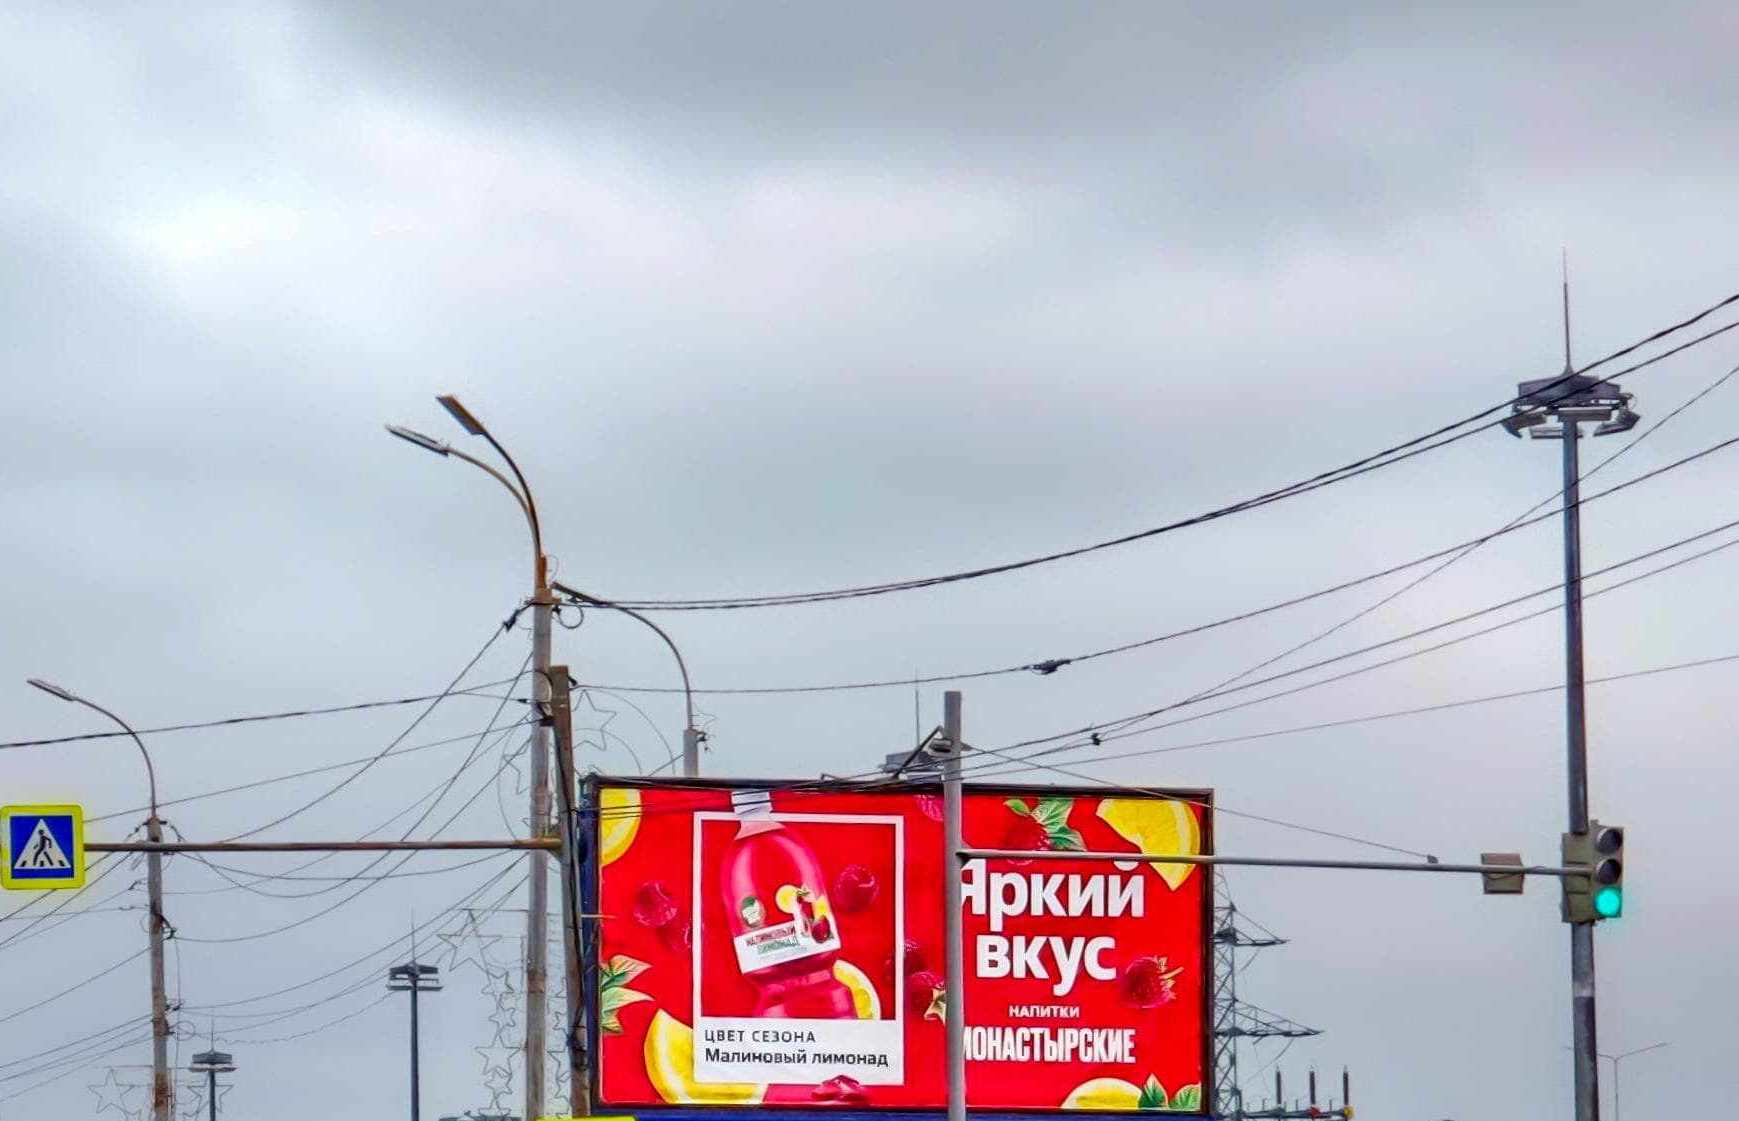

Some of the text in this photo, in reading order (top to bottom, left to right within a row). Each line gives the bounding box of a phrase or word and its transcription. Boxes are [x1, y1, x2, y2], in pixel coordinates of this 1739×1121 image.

[961, 858, 1145, 932] Яркий
[976, 934, 1117, 997] вкус
[1009, 1005, 1080, 1018] НАПИТКИ
[704, 1029, 816, 1043] ЦВЕТ СЕЗОНА
[705, 1047, 889, 1067] Малиновый лимонад
